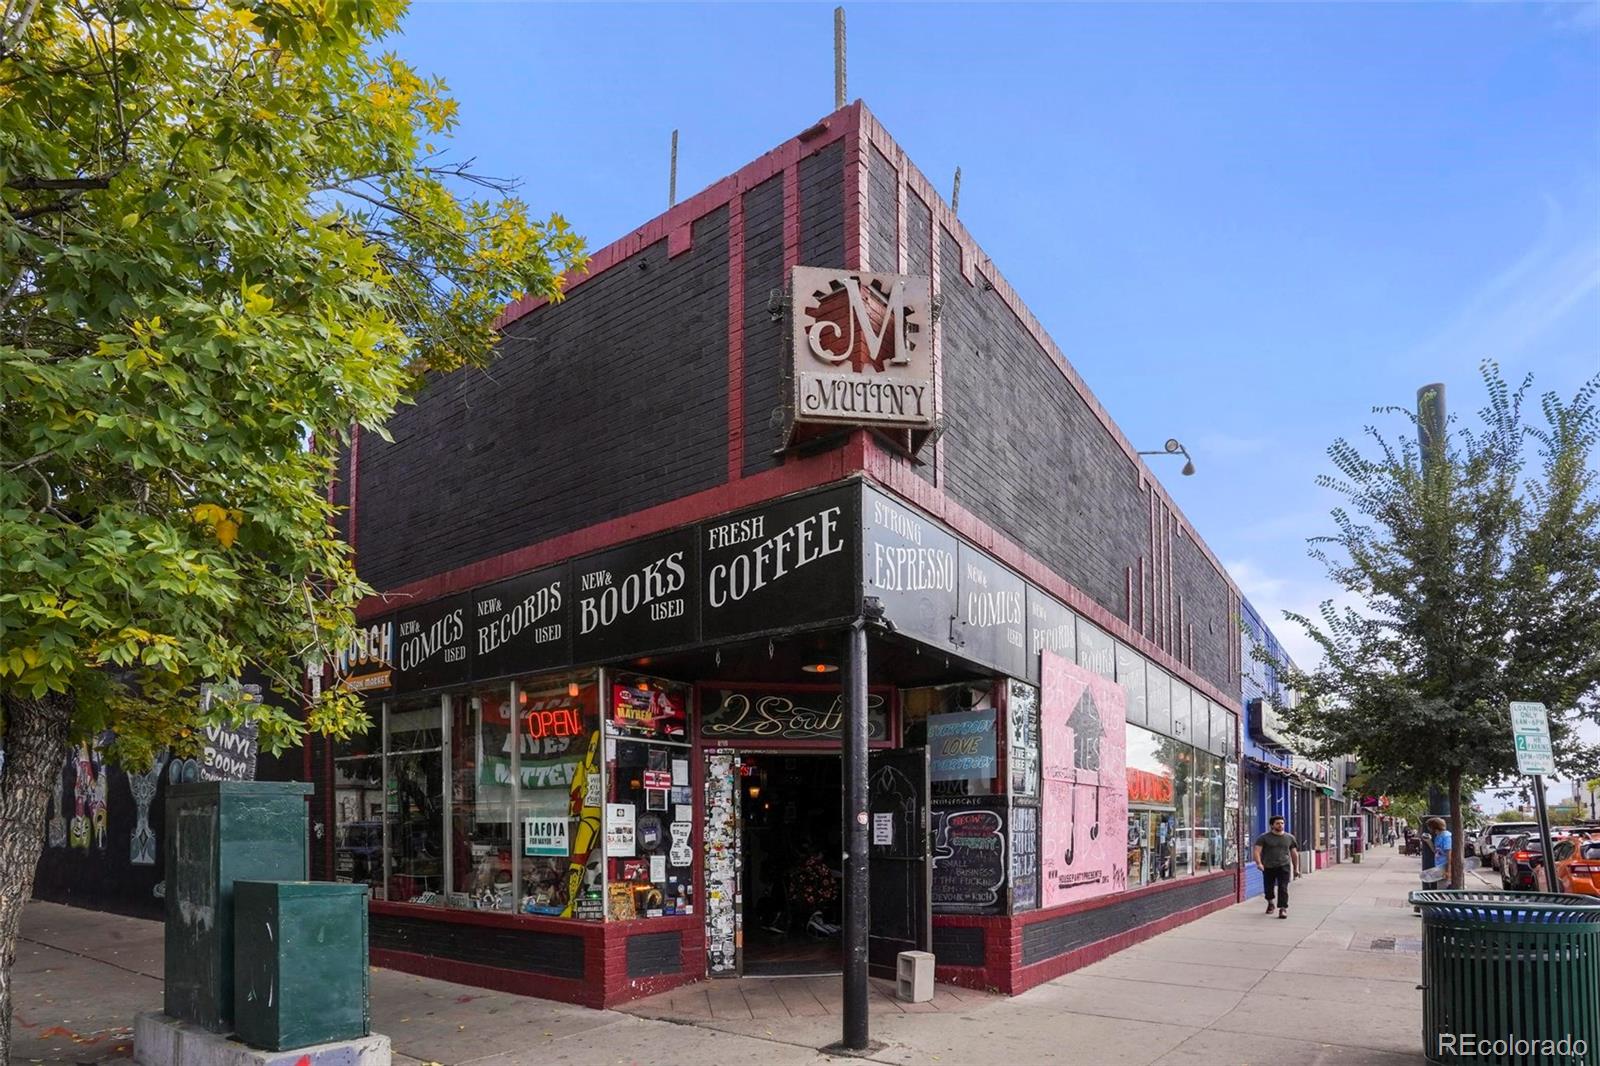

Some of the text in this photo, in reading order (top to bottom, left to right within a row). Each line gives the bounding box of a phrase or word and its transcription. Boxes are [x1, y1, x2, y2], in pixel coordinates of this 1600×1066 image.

[806, 379, 925, 416] MUTINY
[708, 515, 765, 551] FRESH
[873, 500, 922, 546] STRONG
[708, 506, 844, 609] COFFEE
[873, 541, 954, 593] ESPRESSO
[579, 551, 686, 635] BOOKS
[580, 569, 613, 592] NEW&
[477, 597, 502, 617] NEW&
[478, 581, 562, 655] RECORDS
[650, 598, 685, 622] USED
[967, 590, 1022, 628] COMICS
[400, 608, 464, 672] COMICS
[535, 623, 562, 645] USED
[1032, 623, 1075, 655] RECORDS
[444, 645, 466, 664] USED
[528, 708, 581, 739] OPEN
[941, 736, 984, 757] LOVE
[1518, 737, 1526, 749] 2
[203, 746, 248, 780] BOOKS
[528, 822, 565, 837] TAFOYA
[529, 837, 552, 845] FOR MAYOR
